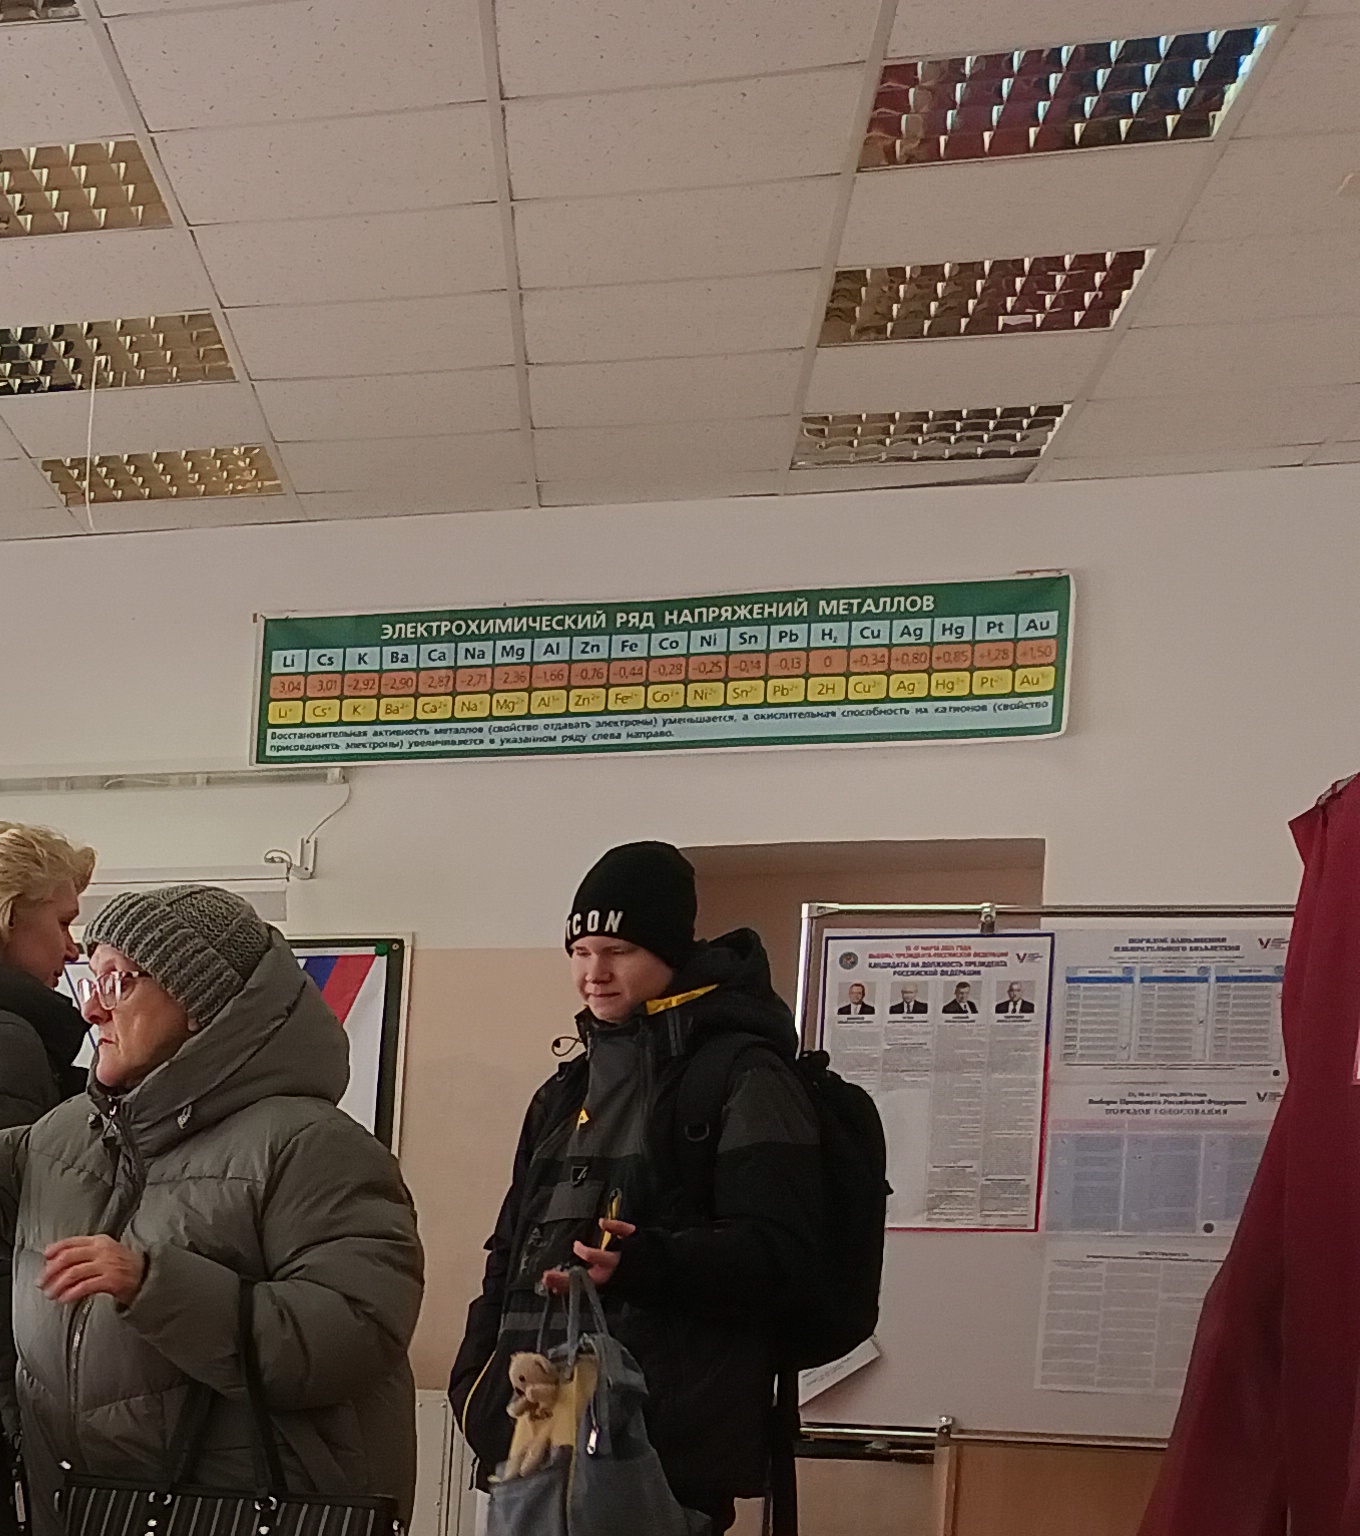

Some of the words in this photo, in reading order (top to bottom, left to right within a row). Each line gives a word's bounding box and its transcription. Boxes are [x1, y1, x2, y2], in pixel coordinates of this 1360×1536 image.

[380, 610, 606, 640] ЭЛЕКТРОХИМИЧЕСКИЙ
[616, 612, 655, 630] РЯД
[664, 598, 808, 626] НАПРЯЖЕНИЙ
[818, 595, 935, 616] МЕТАЛЛОВ
[283, 653, 295, 667] Li
[316, 653, 335, 667] Cs
[357, 652, 369, 665] K
[390, 651, 409, 664] Ba
[427, 649, 447, 662] Ca
[464, 647, 486, 660] Na
[500, 645, 525, 660] Mg
[543, 642, 560, 656] Al
[580, 641, 601, 654] Zn
[620, 639, 639, 653] Fe
[658, 637, 680, 650] Co
[700, 633, 717, 647] Ni
[738, 632, 759, 645] Sn
[778, 629, 800, 643] Pb
[859, 626, 881, 639] Cu
[899, 625, 924, 641] Ag
[941, 623, 965, 639] Hg
[986, 620, 1005, 634] Pt
[1025, 618, 1050, 632] Au
[823, 656, 832, 667] 0
[372, 728, 430, 737] активность
[543, 721, 591, 731] отдавать
[841, 707, 910, 718] способность
[562, 734, 586, 743] ряду
[591, 731, 622, 740] слева
